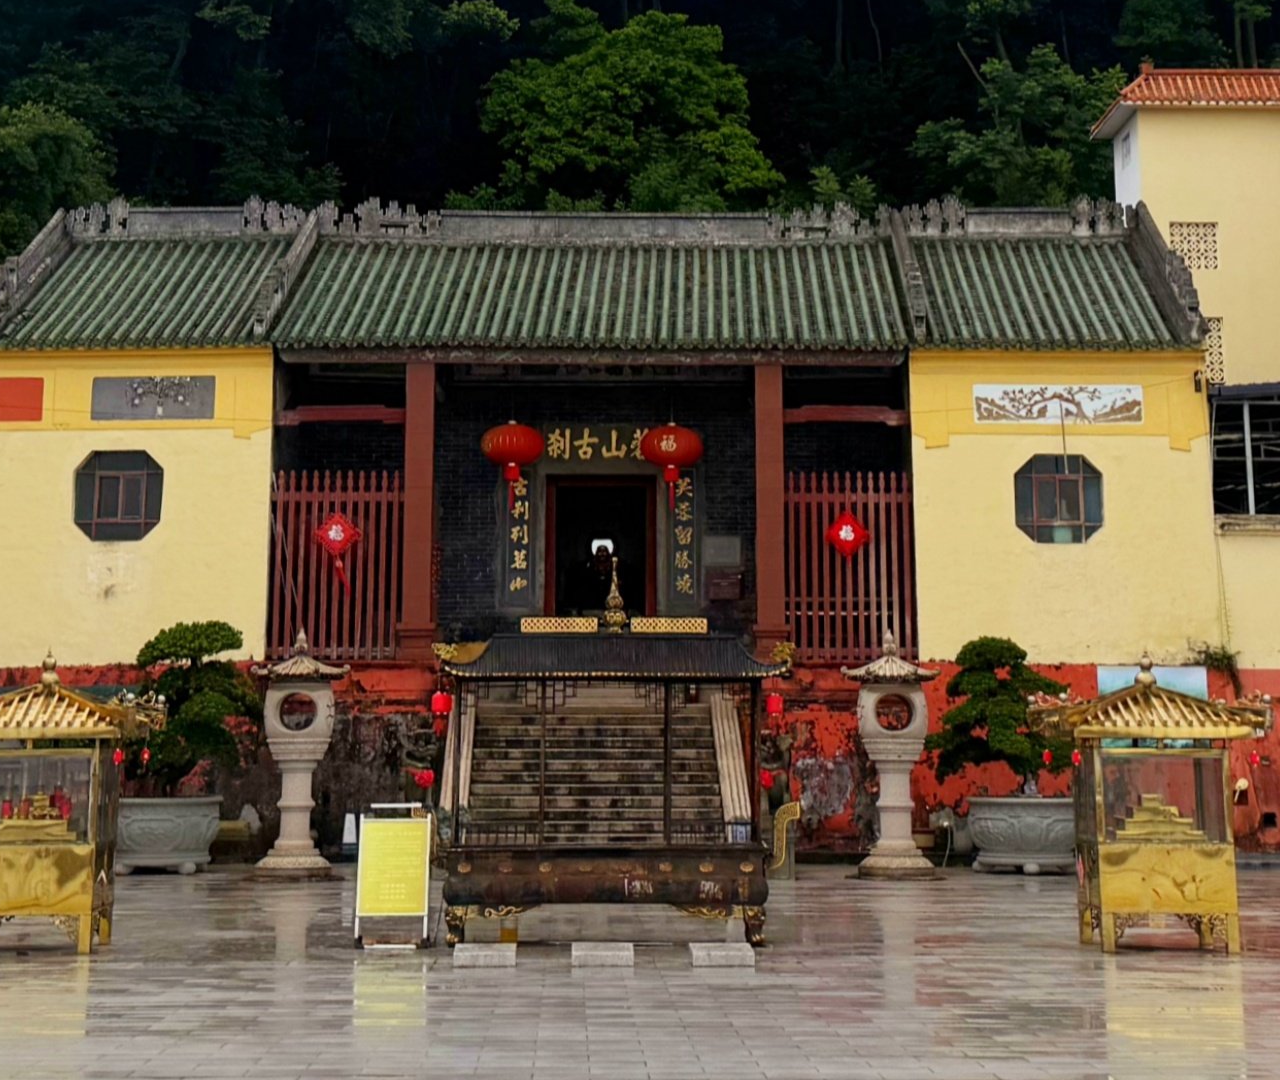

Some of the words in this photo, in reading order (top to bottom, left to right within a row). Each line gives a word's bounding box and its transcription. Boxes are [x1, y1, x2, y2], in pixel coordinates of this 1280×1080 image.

[660, 434, 678, 452] 福
[327, 524, 345, 541] 福
[838, 524, 855, 542] 福
